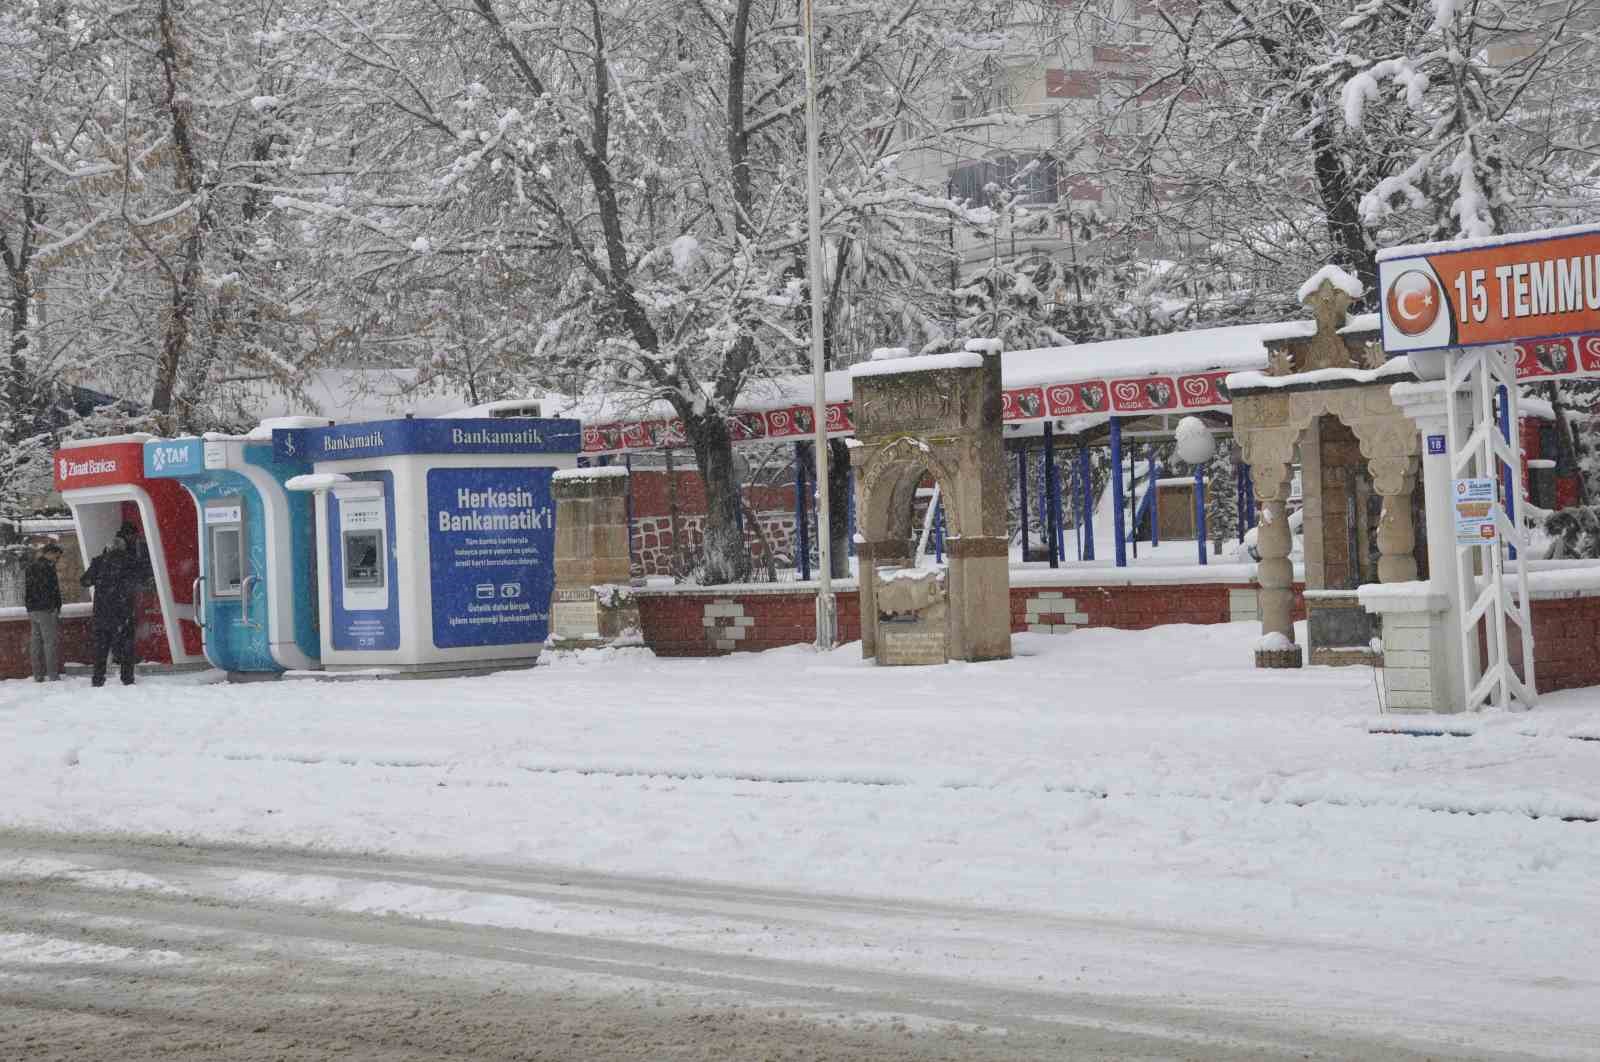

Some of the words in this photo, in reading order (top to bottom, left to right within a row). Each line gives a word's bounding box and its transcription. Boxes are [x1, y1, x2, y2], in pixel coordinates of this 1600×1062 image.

[1454, 269, 1488, 324] 15
[1495, 255, 1600, 319] TEMMU
[324, 431, 384, 451] Bankamatik
[451, 427, 542, 444] Bankamatik
[457, 487, 532, 509] Herkesin
[439, 507, 552, 532] Bankamatik'i
